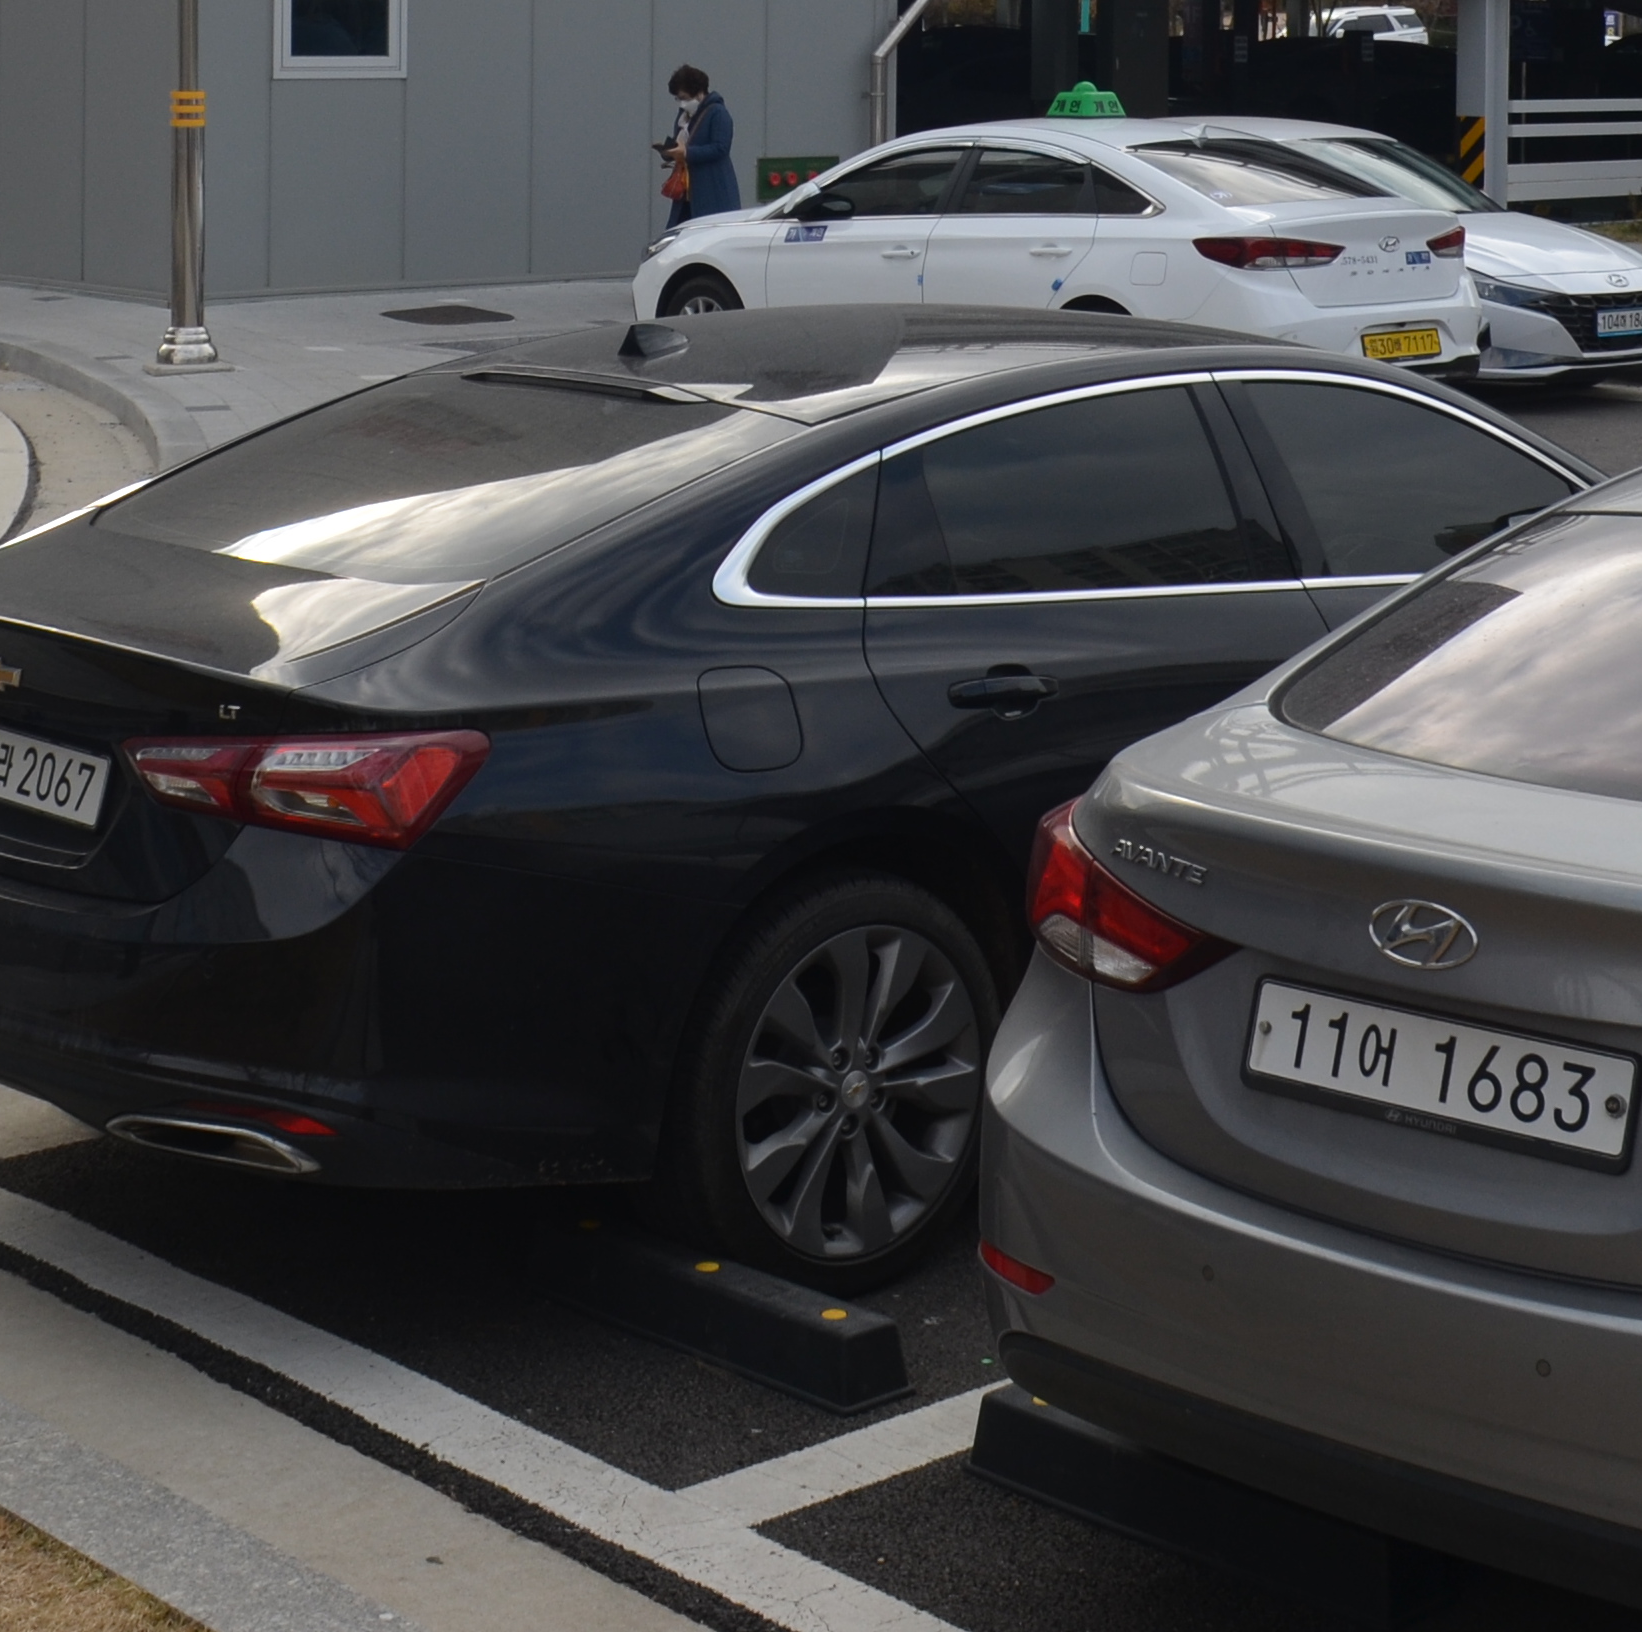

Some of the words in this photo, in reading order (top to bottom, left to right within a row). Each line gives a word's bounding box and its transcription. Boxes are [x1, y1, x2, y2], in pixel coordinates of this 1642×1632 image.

[1054, 99, 1082, 113] 개인
[1093, 100, 1119, 113] 개인
[1350, 265, 1430, 276] SONATA
[1403, 333, 1434, 351] 7117
[219, 704, 241, 719] LT
[16, 747, 96, 811] 2067
[1110, 838, 1208, 885] AVANTE
[1291, 1003, 1397, 1088] 11어
[1434, 1035, 1597, 1133] 1683
[1405, 1112, 1457, 1136] HYUNDAI
